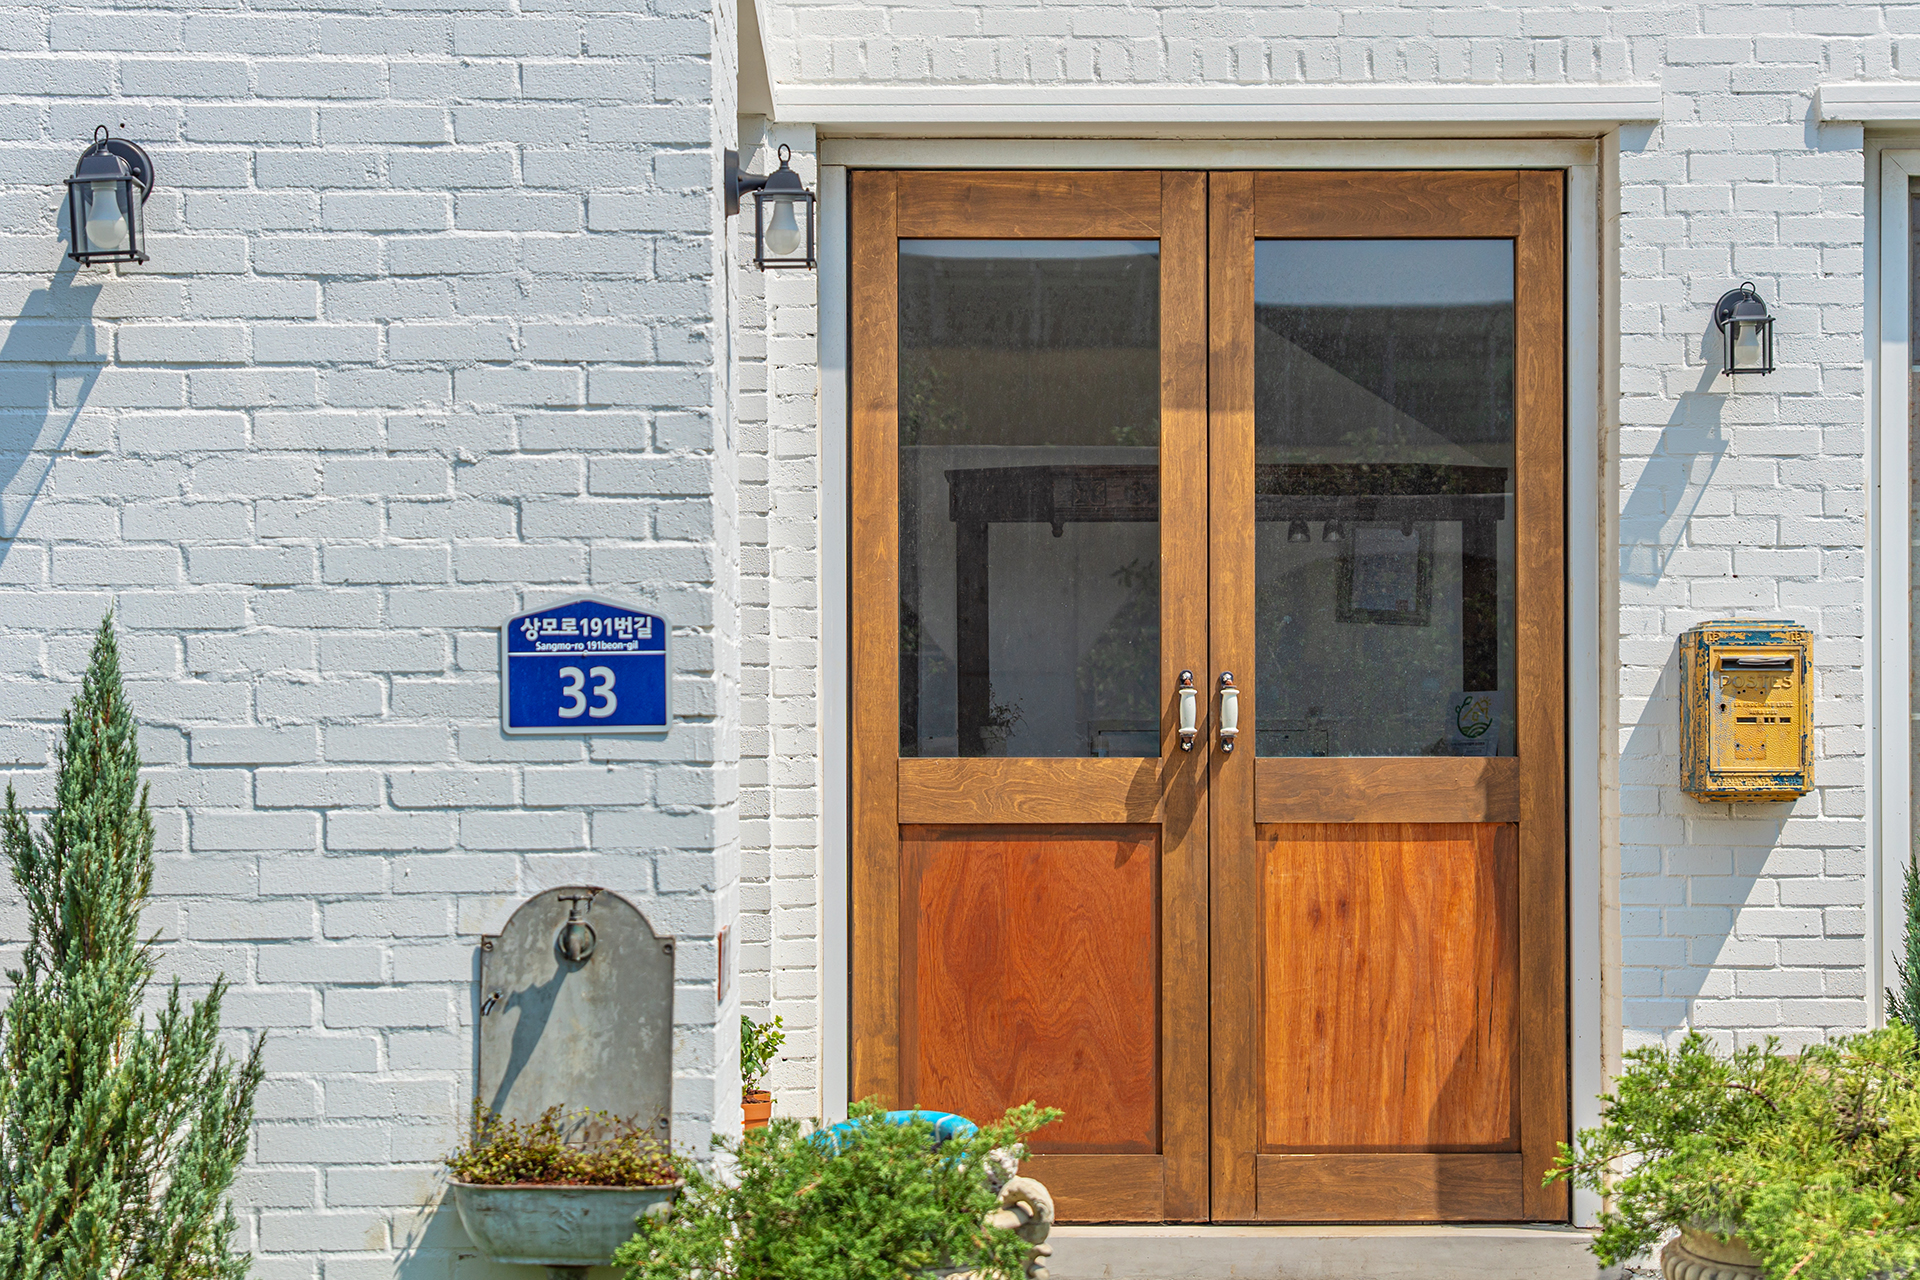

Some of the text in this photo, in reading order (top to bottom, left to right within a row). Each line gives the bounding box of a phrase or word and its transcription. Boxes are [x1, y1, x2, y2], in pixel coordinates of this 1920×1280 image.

[520, 616, 653, 641] 상모로191번길
[535, 640, 639, 652] Sangmo-ro 191beon-gil
[1719, 675, 1794, 689] POSTES
[558, 666, 618, 718] 33
